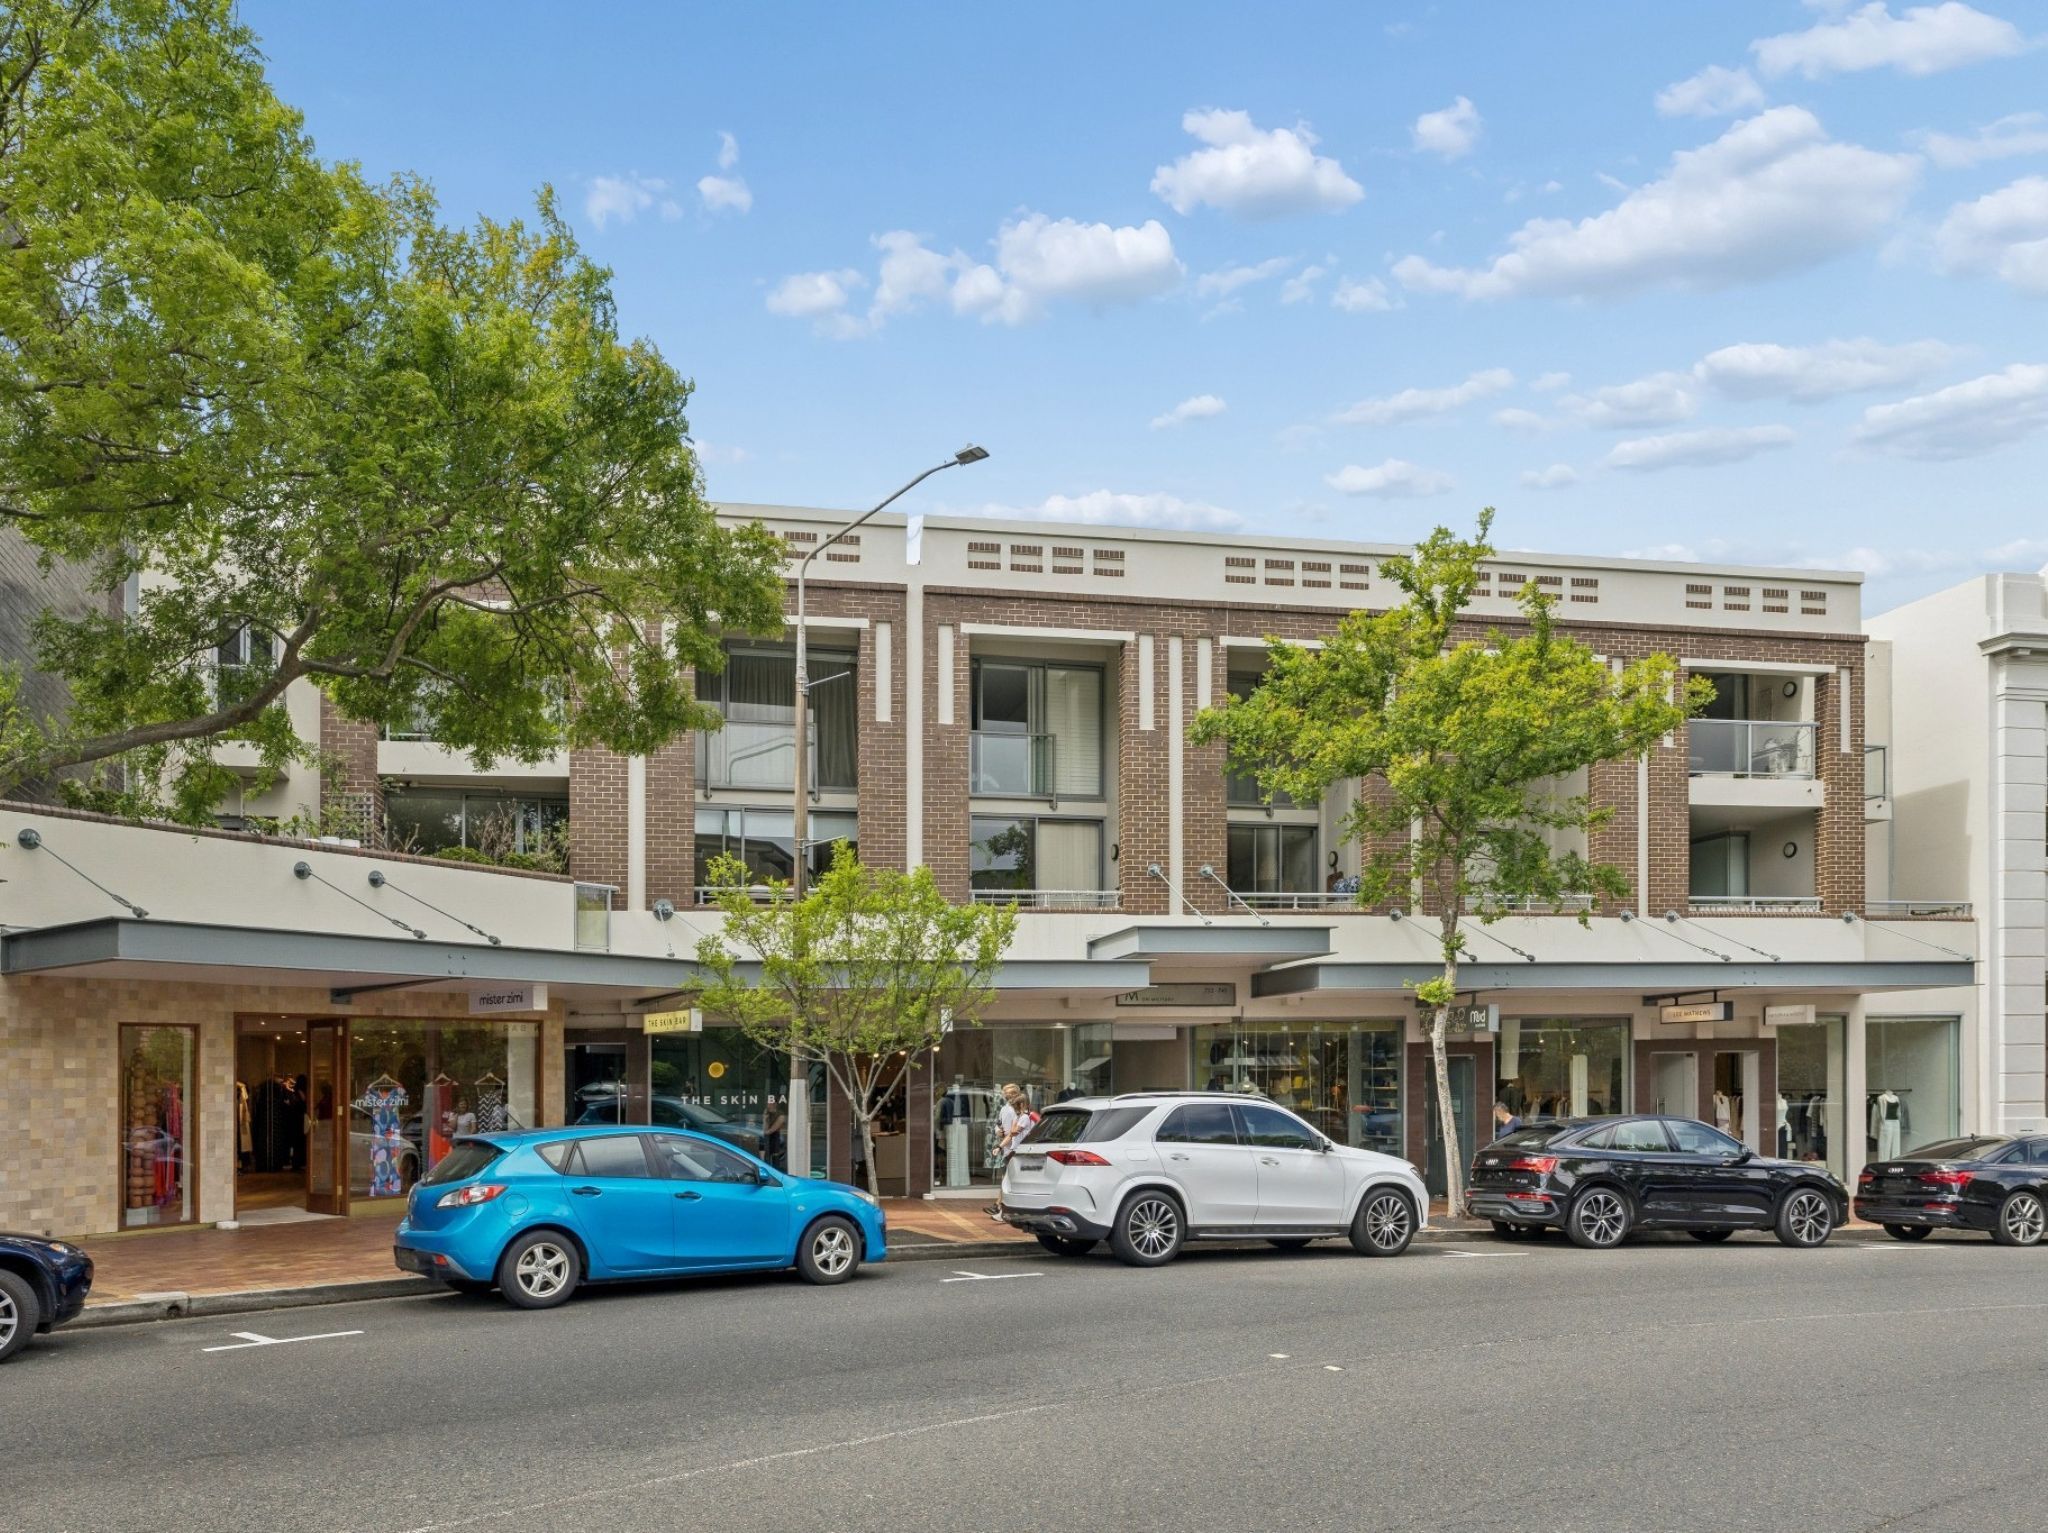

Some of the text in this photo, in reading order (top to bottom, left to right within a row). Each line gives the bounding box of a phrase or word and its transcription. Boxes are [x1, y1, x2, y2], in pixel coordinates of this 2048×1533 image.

[479, 991, 523, 1006] mister zimi
[648, 1019, 658, 1028] THE
[355, 1095, 409, 1107] mister zimi
[681, 1095, 711, 1105] THE
[767, 1094, 788, 1104] BA
